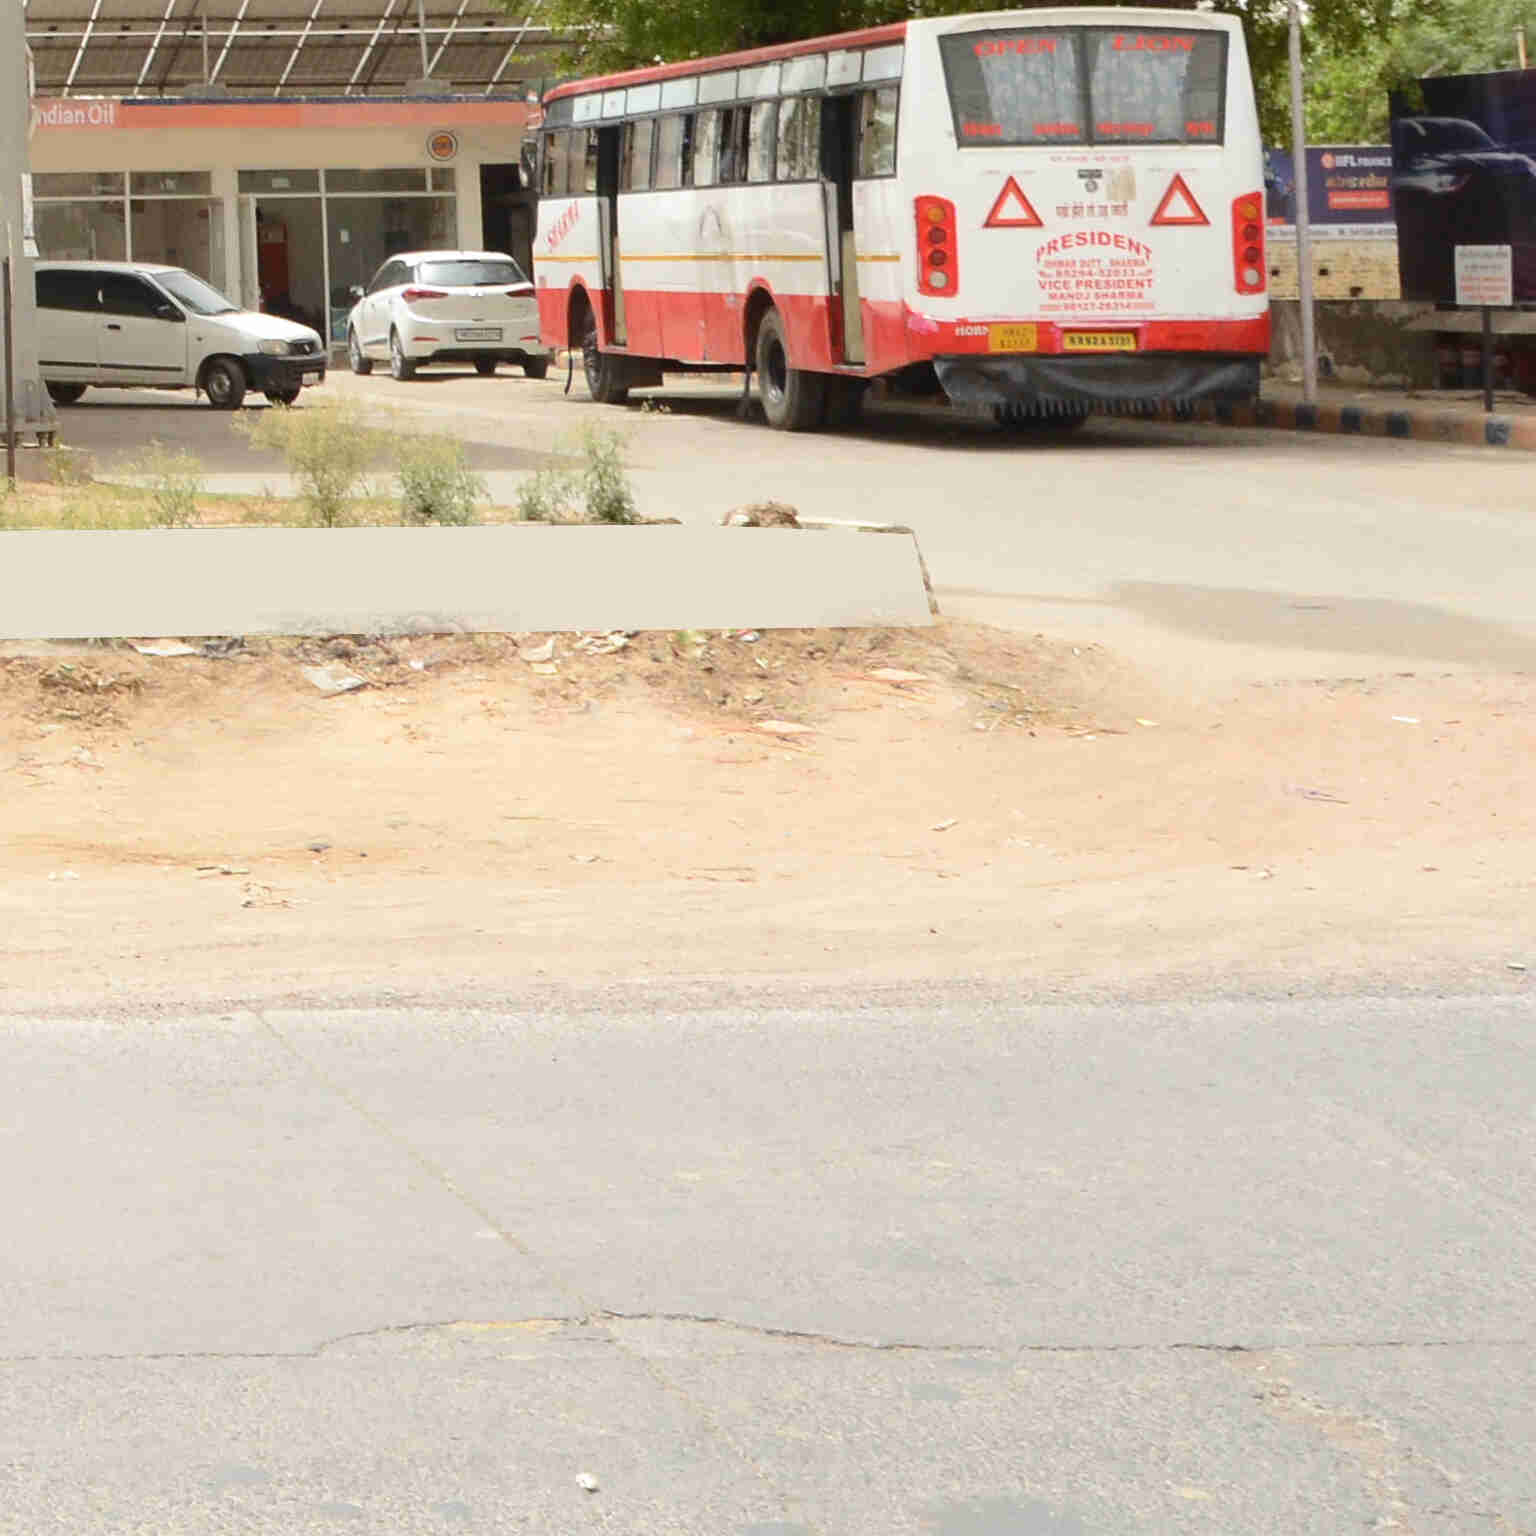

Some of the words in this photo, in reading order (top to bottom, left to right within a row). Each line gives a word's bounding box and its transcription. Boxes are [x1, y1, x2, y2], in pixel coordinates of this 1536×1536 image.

[972, 37, 1056, 57] OPEN
[38, 103, 85, 125] ndian
[88, 103, 115, 124] Oil
[1036, 231, 1152, 264] PRESIDENT
[1039, 279, 1073, 289] VICE
[1075, 278, 1153, 289] PRESIDENT
[1095, 291, 1144, 300] SHARMA
